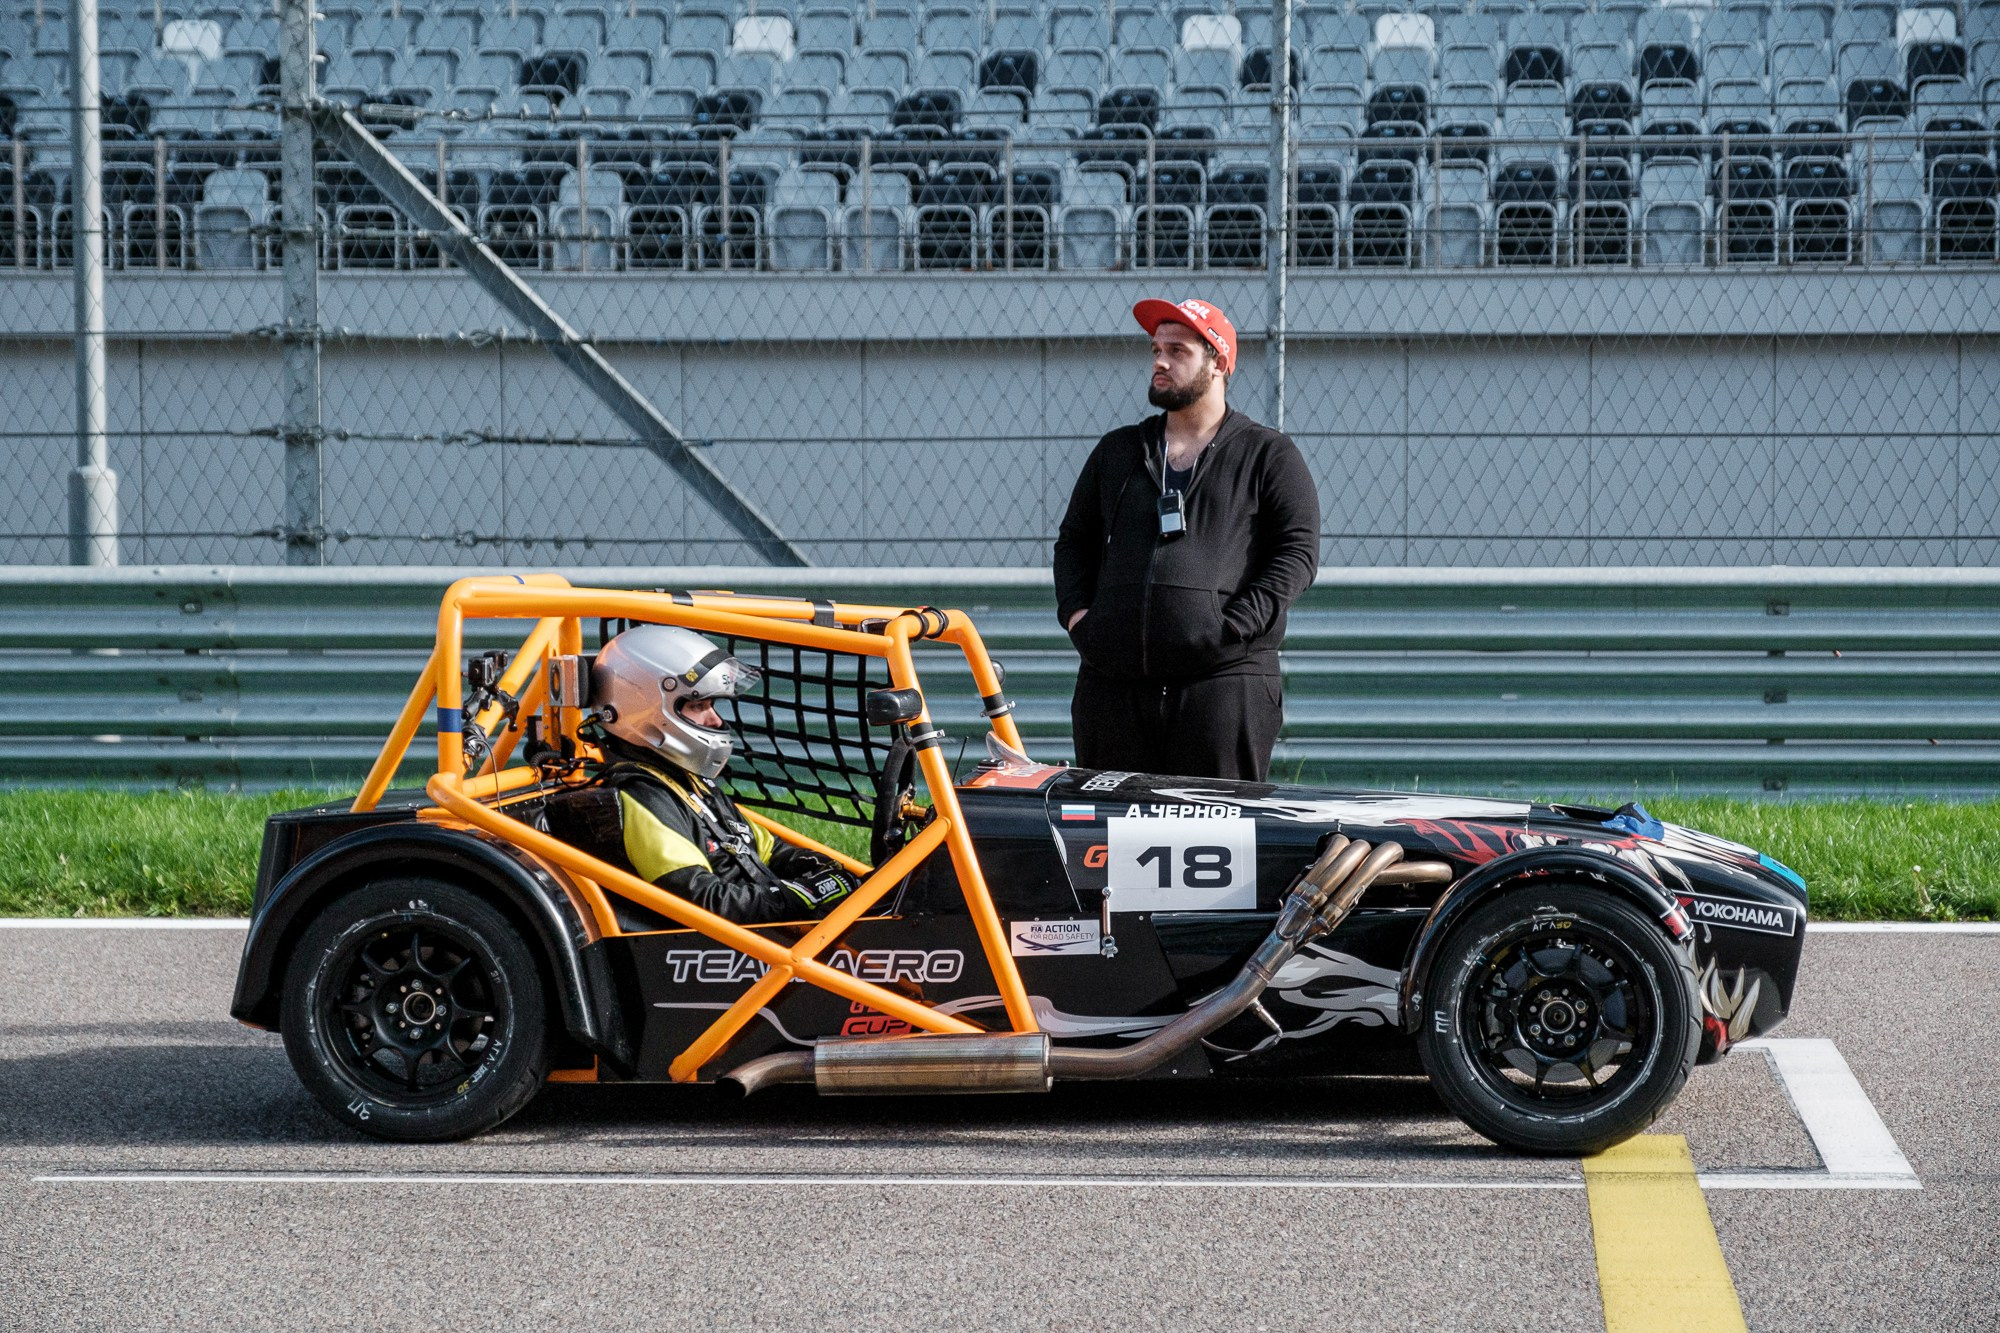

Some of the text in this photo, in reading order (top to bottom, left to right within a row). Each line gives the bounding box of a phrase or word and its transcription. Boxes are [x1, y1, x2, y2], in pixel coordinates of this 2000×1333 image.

[1136, 846, 1233, 889] 18
[818, 879, 838, 895] OMP
[1693, 900, 1785, 928] YOKOHAMA
[1045, 924, 1080, 933] ACTION
[1066, 932, 1095, 941] SAFETY
[666, 950, 964, 983] TEA AERO
[847, 1019, 908, 1036] CUP
